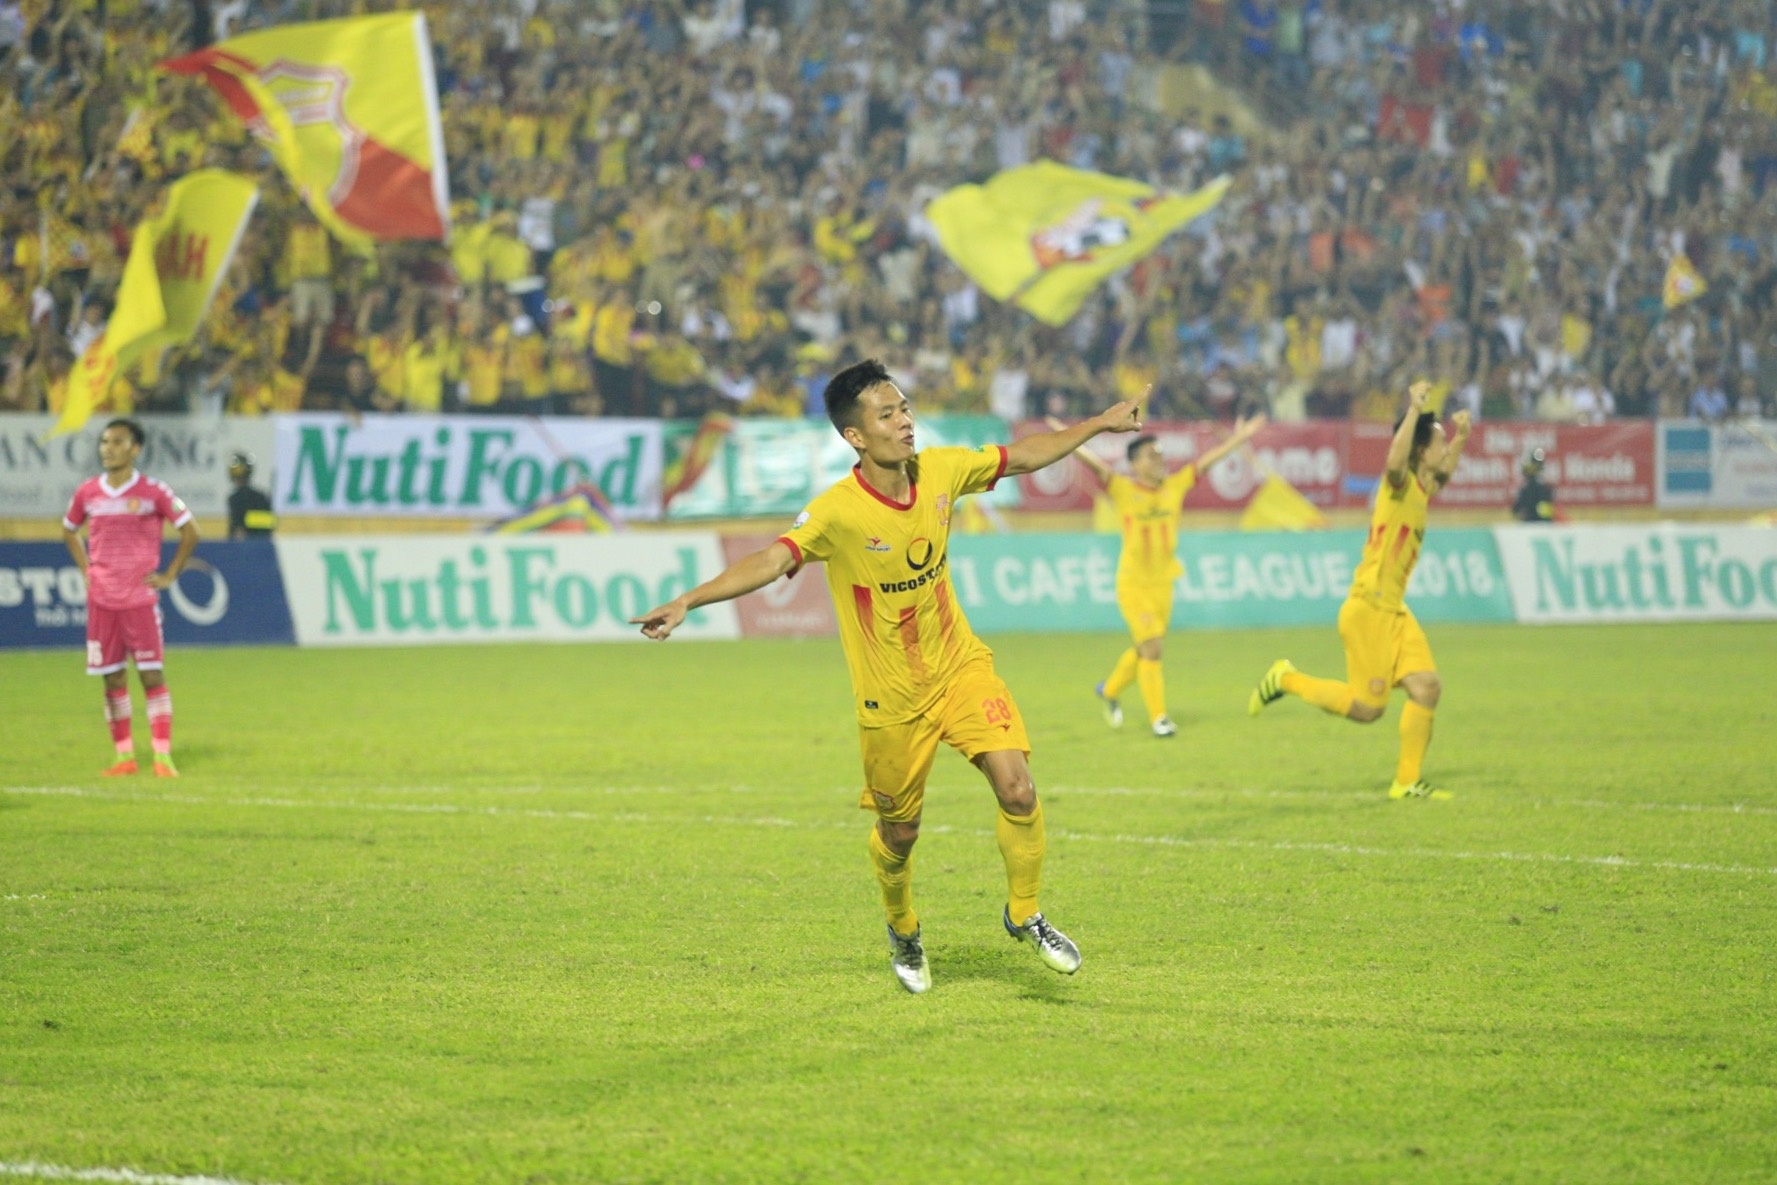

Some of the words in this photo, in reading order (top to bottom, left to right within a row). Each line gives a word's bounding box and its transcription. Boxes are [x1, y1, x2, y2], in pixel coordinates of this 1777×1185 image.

[287, 426, 644, 506] NutiFood
[320, 547, 707, 632] NutiFood
[993, 547, 1116, 606] CAFÉ
[982, 697, 1012, 724] 28
